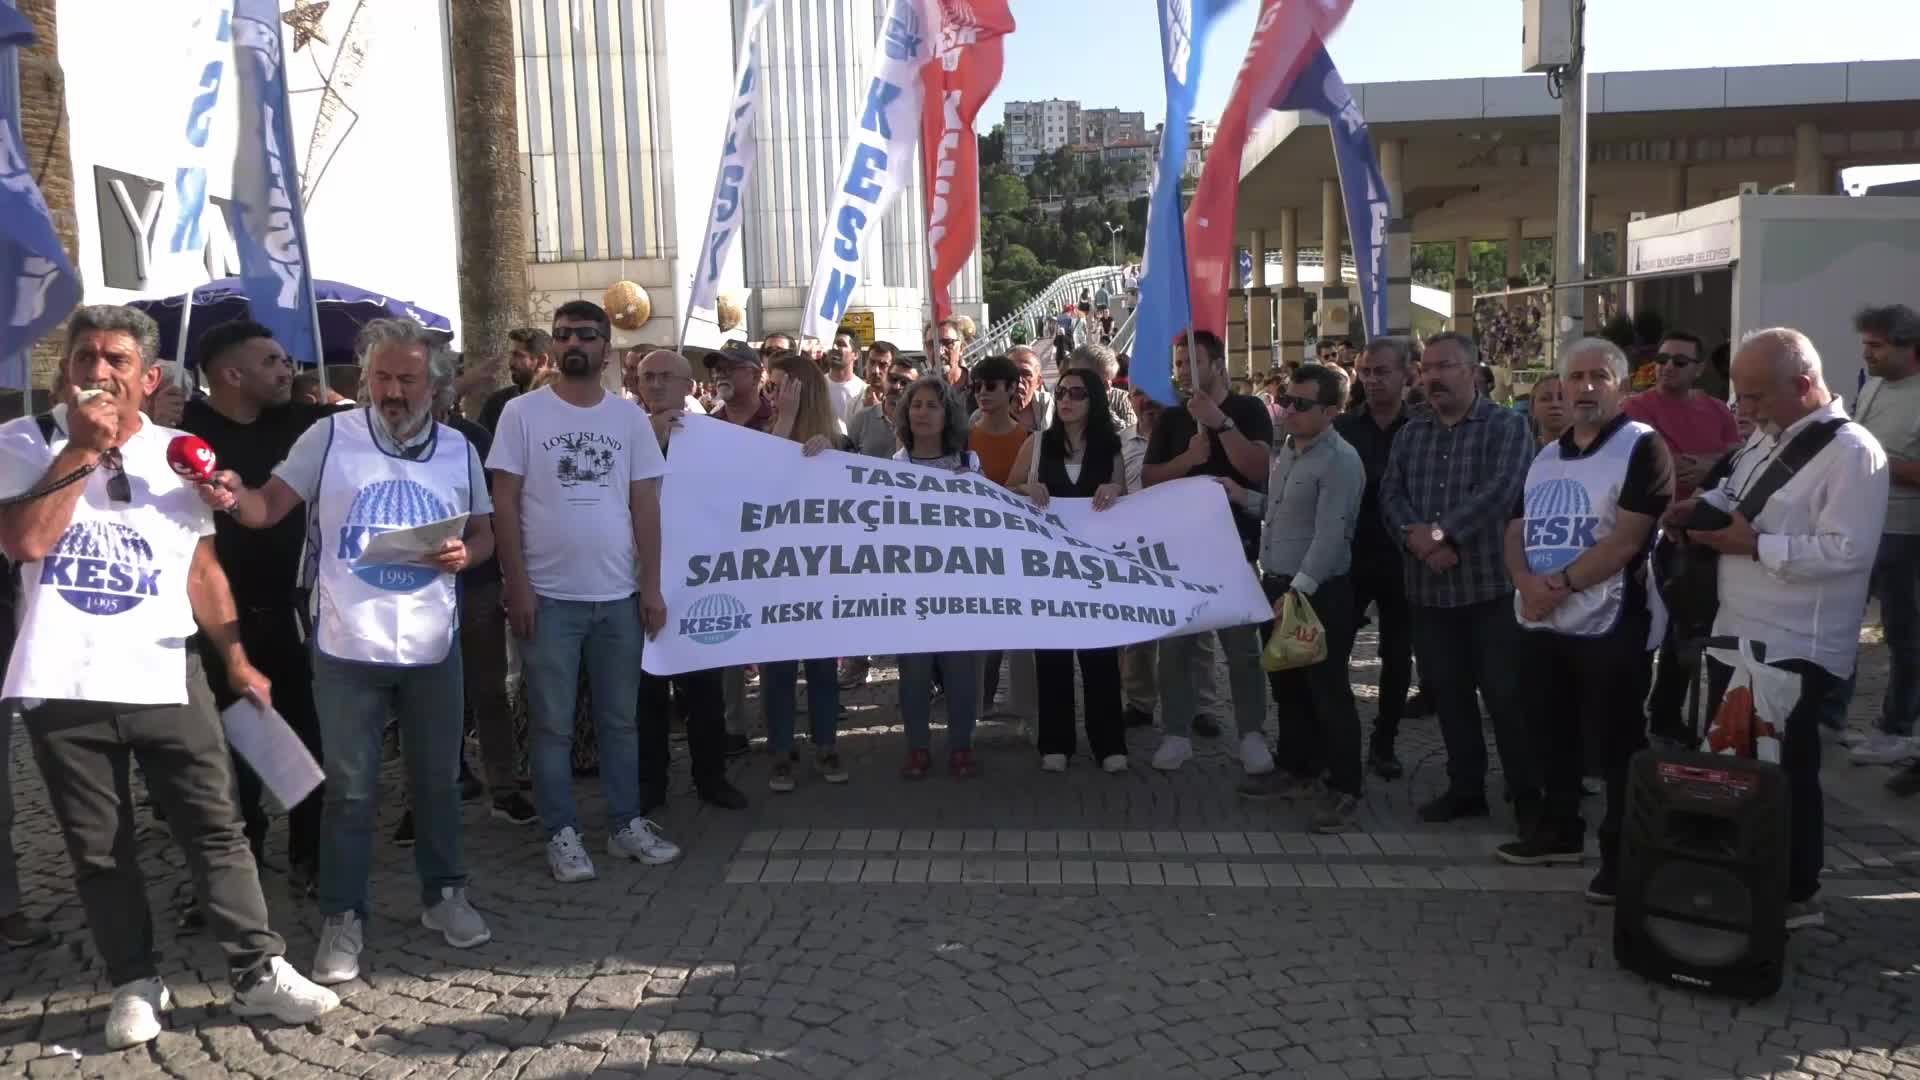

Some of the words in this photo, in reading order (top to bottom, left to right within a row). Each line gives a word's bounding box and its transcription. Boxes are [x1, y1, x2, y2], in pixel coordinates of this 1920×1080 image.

[542, 432, 575, 451] LOST
[577, 432, 622, 451] ISLAND
[740, 495, 1054, 540] EMEKÇİLERDEN
[1527, 516, 1600, 547] ESK
[40, 555, 162, 596] KESK
[379, 569, 415, 585] 1995
[685, 544, 1005, 587] SARAYLARDAN
[86, 596, 119, 613] 1995
[761, 601, 824, 624] KESK
[832, 593, 907, 619] İZMİR
[915, 597, 1022, 620] ŞUBELER
[1031, 599, 1177, 627] PLATFORMU
[679, 613, 752, 634] KESK
